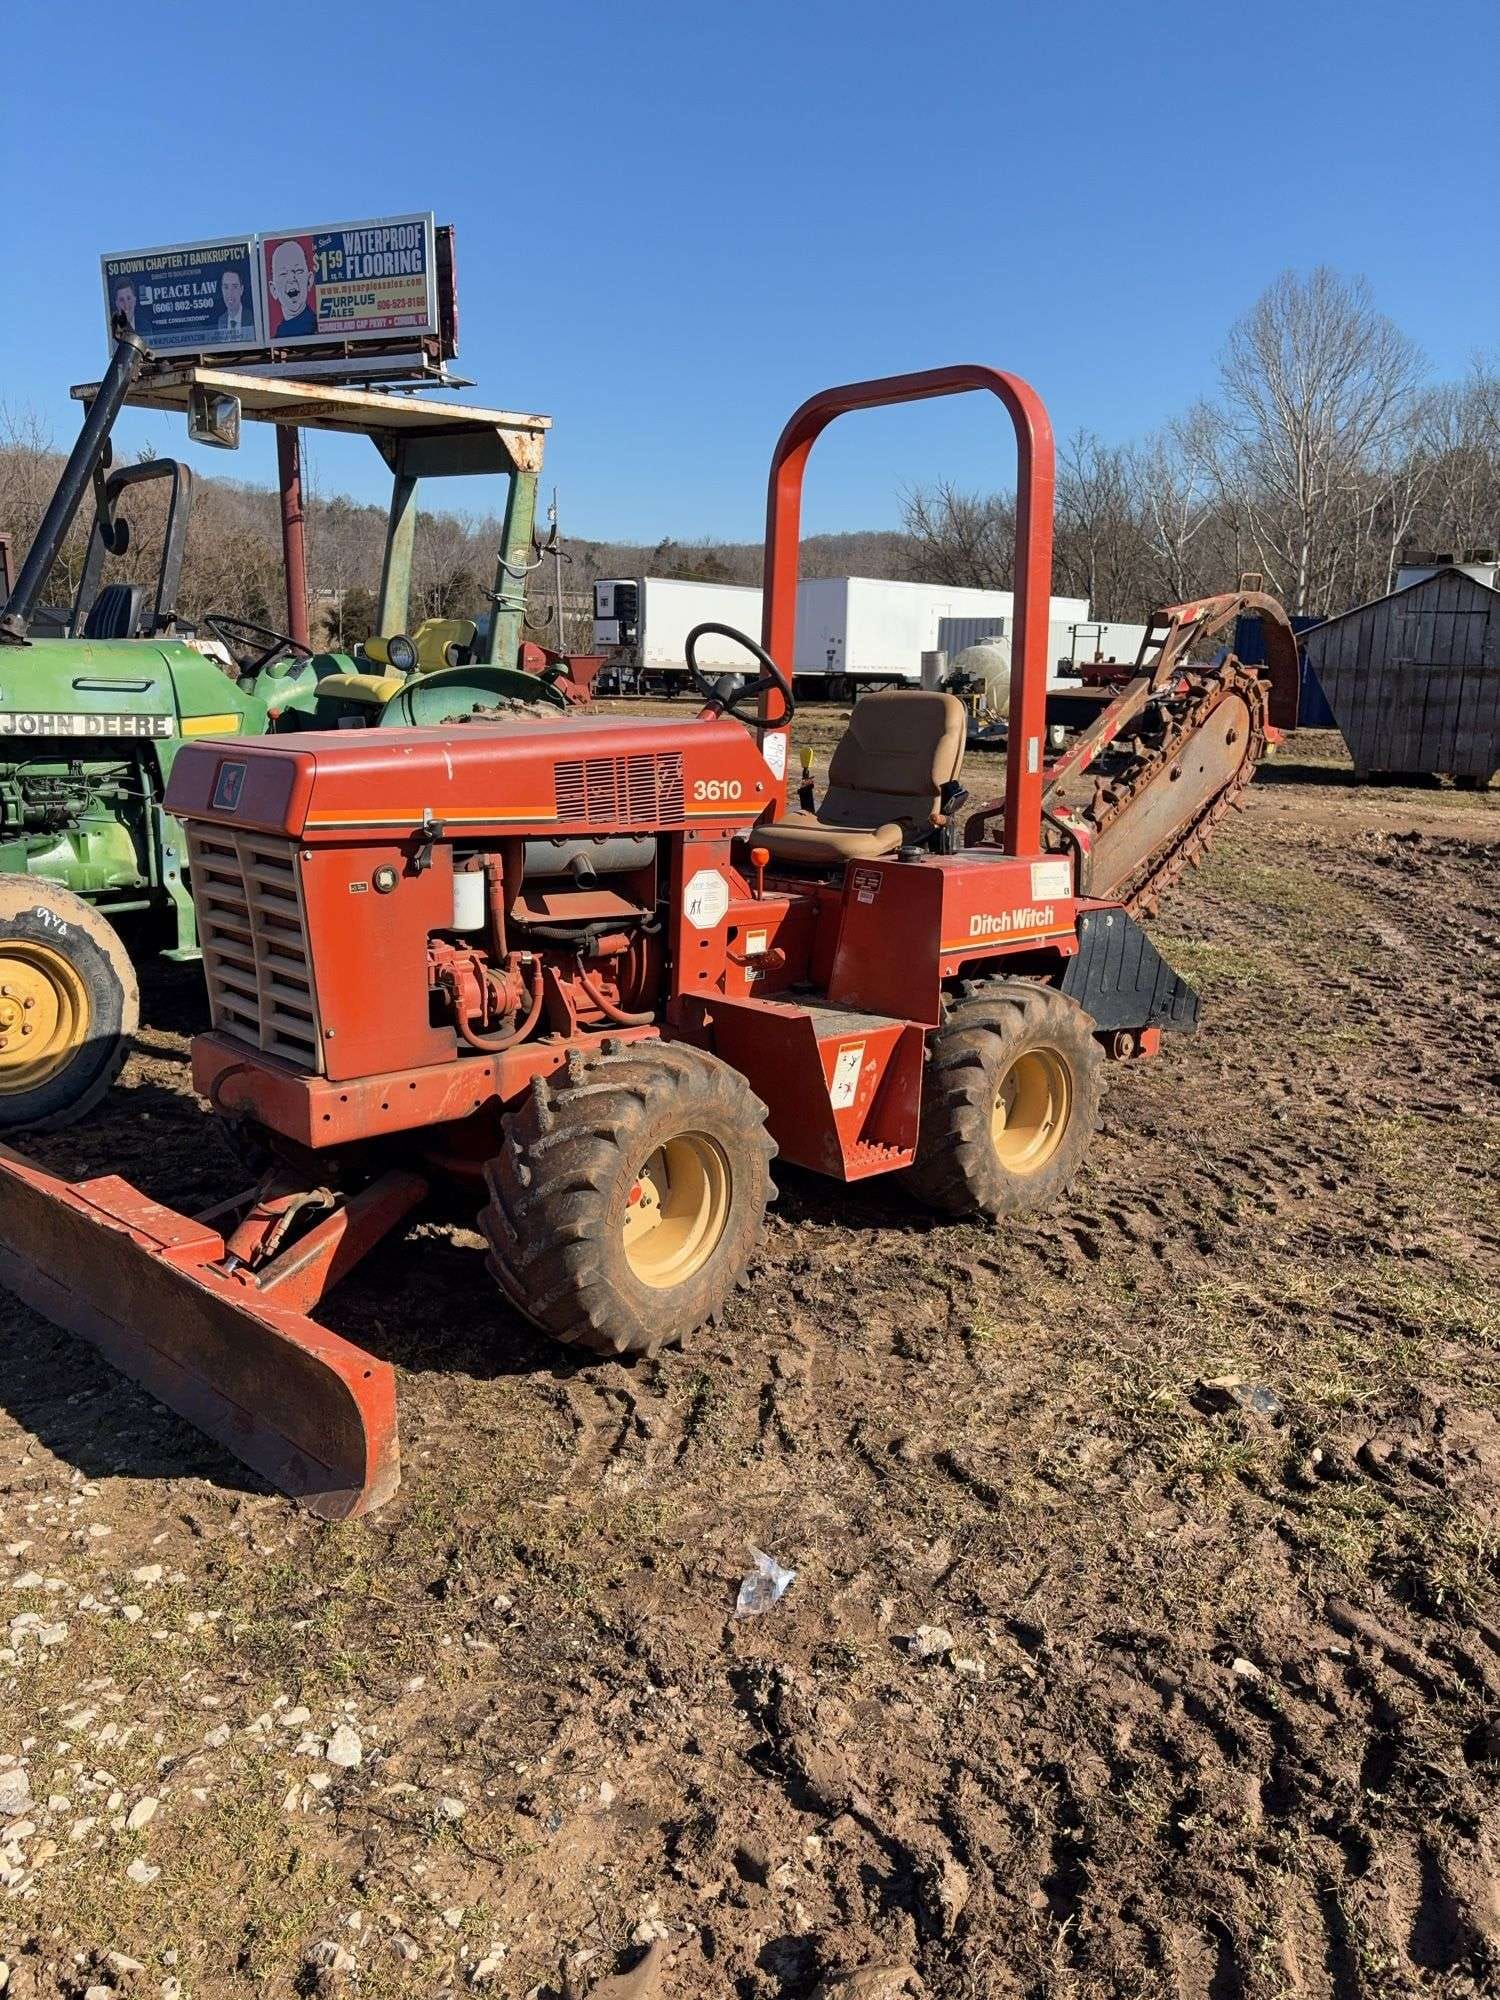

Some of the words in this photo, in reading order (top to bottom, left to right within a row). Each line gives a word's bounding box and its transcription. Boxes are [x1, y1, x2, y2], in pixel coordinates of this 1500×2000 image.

[342, 224, 422, 256] WATERPROOF
[120, 260, 144, 274] DOWN
[146, 254, 183, 271] CHAPTER
[184, 254, 188, 266] 7
[190, 246, 246, 265] BANKRUPTCY
[345, 249, 422, 279] FLOORING
[153, 284, 190, 300] PEACE
[192, 281, 217, 296] LAW
[319, 294, 375, 318] SURPLUS
[2, 714, 74, 735] JOHN
[85, 715, 167, 736] DEERE
[693, 779, 742, 801] 3610
[969, 911, 1011, 937] Ditch
[1012, 905, 1054, 929] Witch
